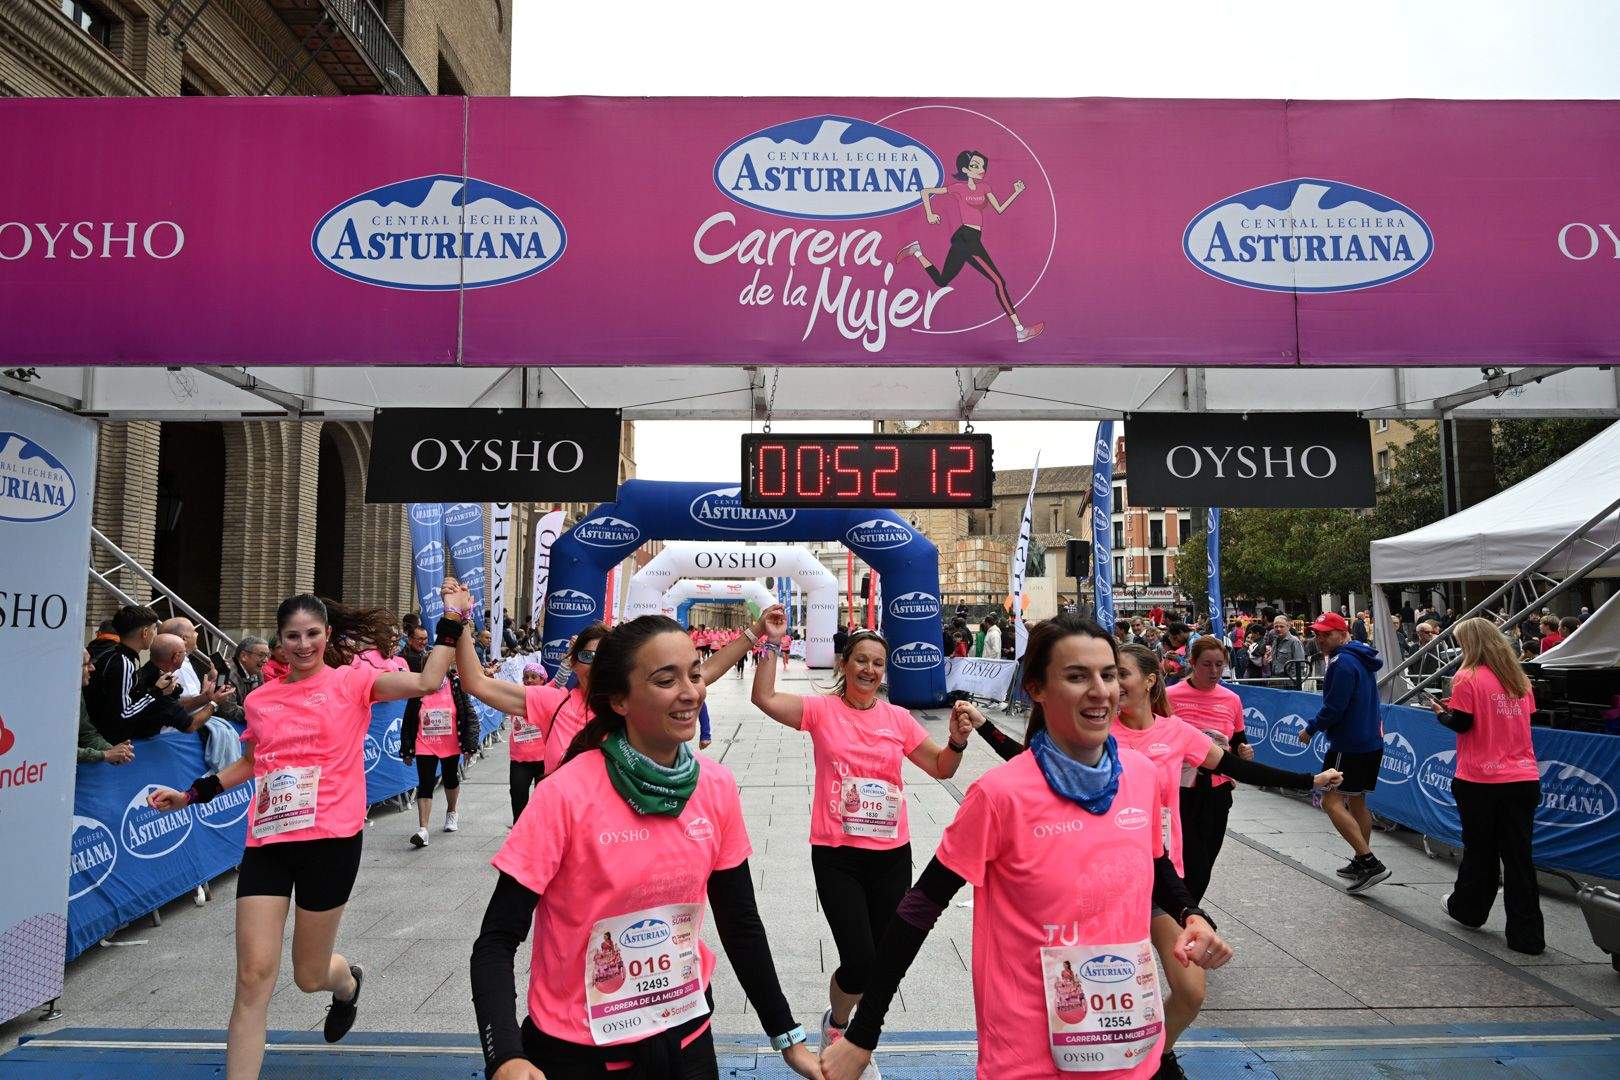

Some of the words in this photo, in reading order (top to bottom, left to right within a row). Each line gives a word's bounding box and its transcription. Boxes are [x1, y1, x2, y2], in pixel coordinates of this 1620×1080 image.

[768, 151, 838, 161] CENTRAL
[847, 152, 918, 162] LECHERA
[732, 153, 925, 192] ASTURIANA
[372, 215, 450, 225] CENTRAL
[458, 214, 538, 225] LECHERA
[1241, 219, 1317, 229] CENTRAL
[1327, 218, 1405, 228] LECHERA
[0, 220, 185, 260] OYSHO
[331, 217, 546, 260] ASTURIANA
[694, 211, 882, 267] Carrera
[1203, 221, 1416, 262] ASTURIANA
[739, 268, 774, 306] de
[783, 267, 807, 307] la
[802, 262, 954, 353] Mujer
[411, 438, 584, 473] OYSHO
[1166, 445, 1337, 478] OYSHO
[22, 466, 64, 481] LECHERA
[698, 501, 788, 520] ASTURIANA
[578, 527, 635, 540] ASTURIANA
[852, 532, 909, 543] ASTURIANA
[695, 552, 777, 568] OYSHO
[893, 602, 938, 614] ASTURIANA
[895, 652, 940, 663] ASTURIANA
[962, 661, 1002, 679] OYSHO
[200, 787, 250, 819] ASTURIANA
[272, 792, 293, 805] 016
[862, 800, 883, 811] 016
[128, 807, 191, 850] ASTURIANA
[600, 828, 650, 845] OYSHO
[1034, 819, 1084, 839] OYSHO
[623, 929, 669, 945] ASTURIANA
[1042, 920, 1079, 947] TU
[628, 954, 671, 977] 016
[1085, 966, 1133, 977] ASTURIANA
[636, 977, 669, 992] 12493
[604, 1001, 639, 1014] CARRERA
[639, 998, 650, 1007] DE
[651, 995, 661, 1003] LA
[662, 988, 684, 1000] MUJER
[1090, 993, 1134, 1011] 016
[602, 1016, 642, 1034] OYSHO
[1098, 1016, 1132, 1028] 12554
[1065, 1035, 1101, 1043] CARRERA
[1125, 1030, 1145, 1039] MUJER
[1064, 1051, 1105, 1062] OYSHO
